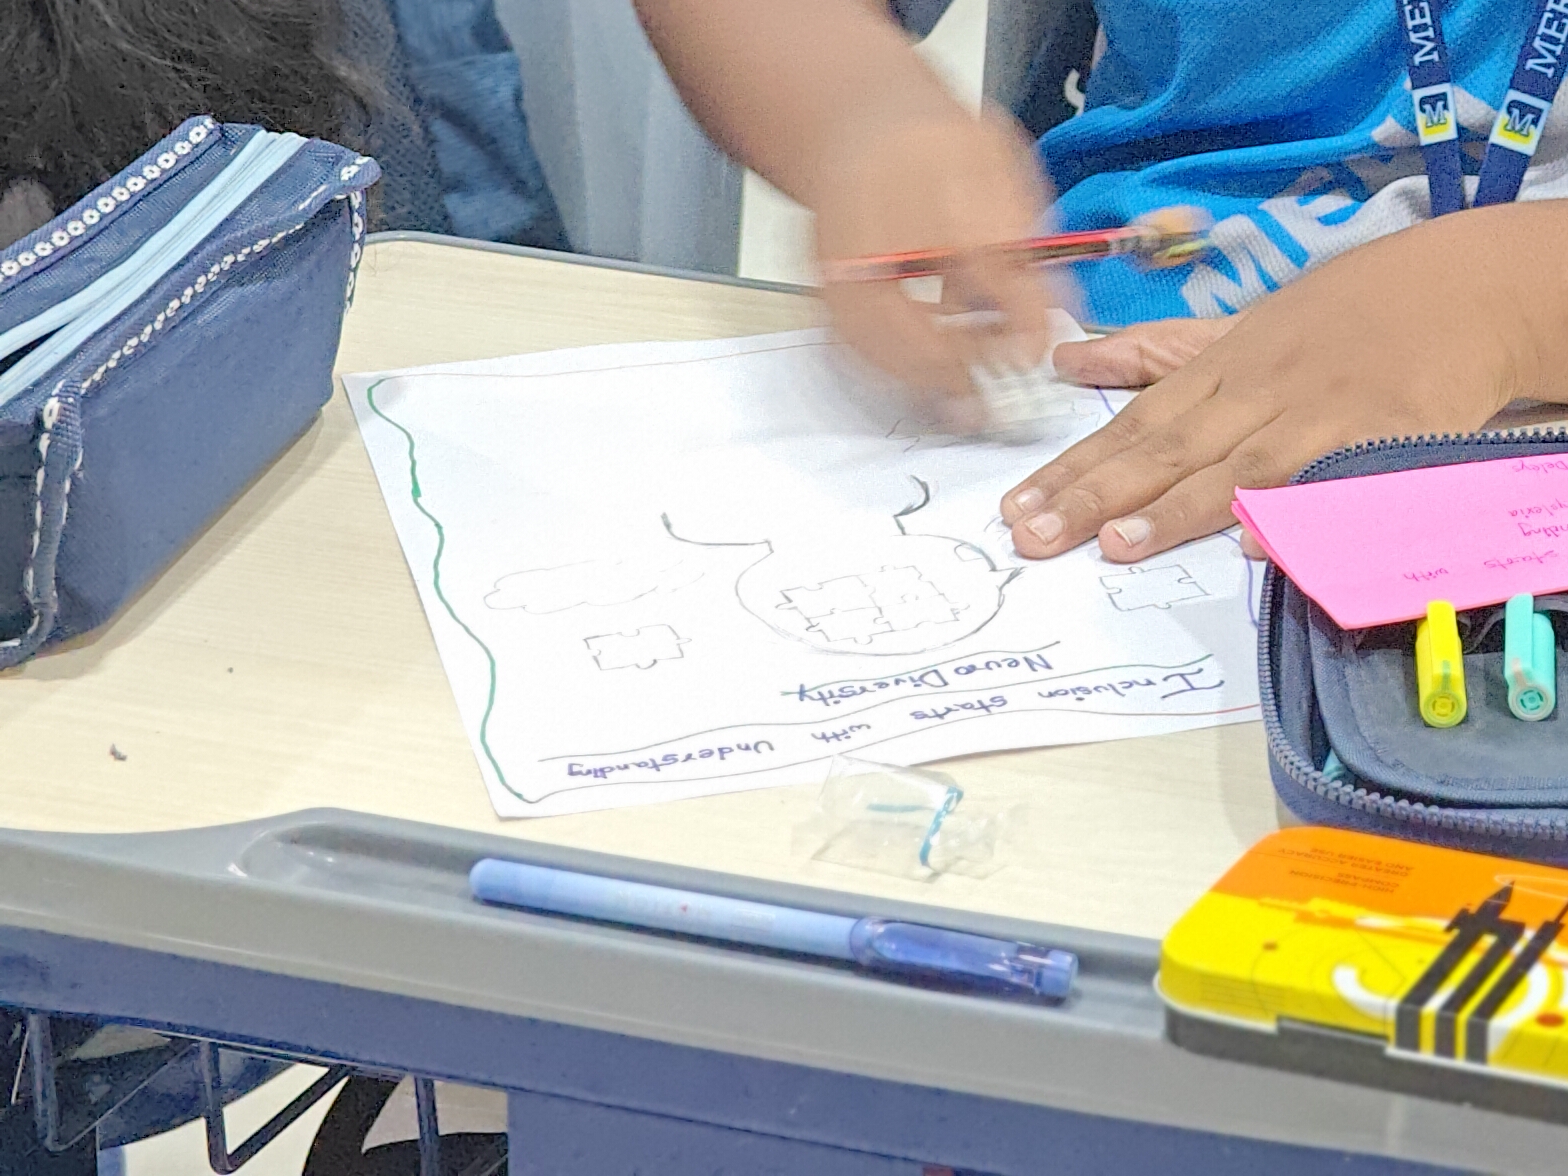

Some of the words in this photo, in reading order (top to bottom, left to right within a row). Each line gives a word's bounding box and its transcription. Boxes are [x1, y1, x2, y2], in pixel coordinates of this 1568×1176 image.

[1037, 667, 1225, 701] Inclusion
[909, 693, 1010, 722] starts
[810, 723, 873, 743] with
[565, 740, 776, 781] Understanding
